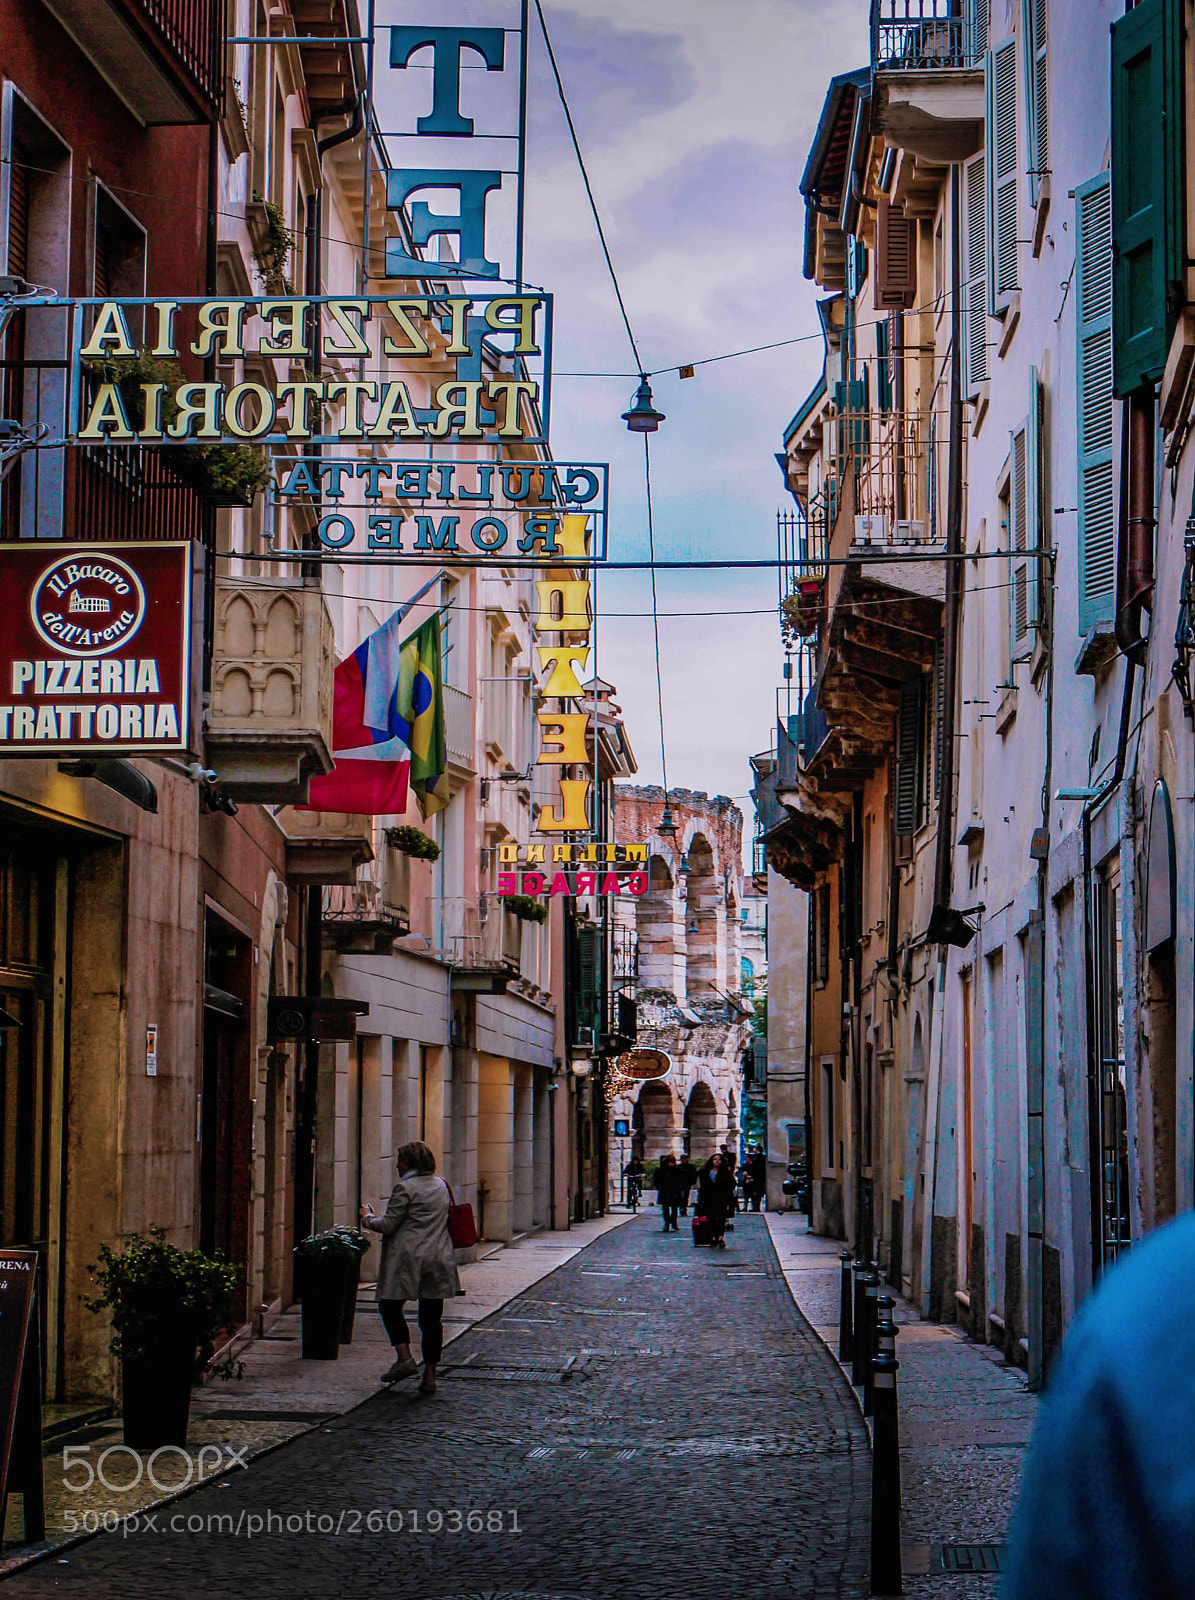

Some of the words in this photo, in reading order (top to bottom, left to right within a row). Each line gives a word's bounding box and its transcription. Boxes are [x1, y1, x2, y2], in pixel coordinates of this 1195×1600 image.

[47, 574, 69, 598] Il
[64, 564, 131, 595] Bacaro
[42, 610, 136, 646] dell'Arena
[12, 659, 161, 695] PIZZERIA
